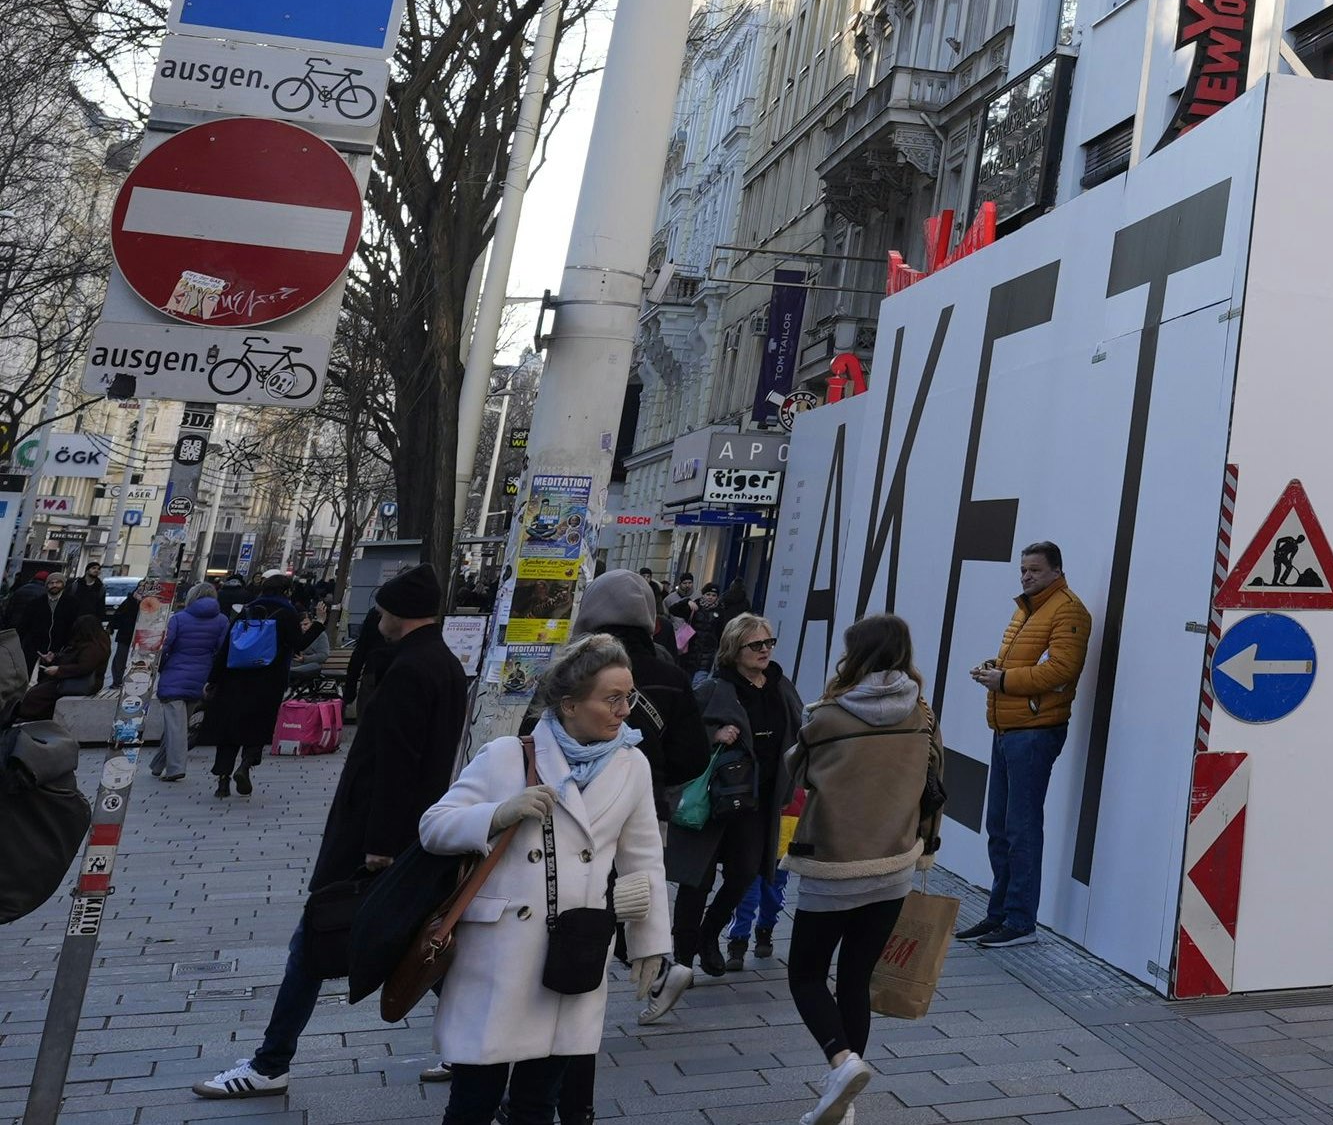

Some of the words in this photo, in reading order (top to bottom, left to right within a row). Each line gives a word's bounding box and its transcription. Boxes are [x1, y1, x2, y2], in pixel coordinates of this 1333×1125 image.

[161, 59, 270, 90] ausgen.
[780, 312, 792, 351] TAILOR
[91, 347, 205, 376] ausgen.
[55, 446, 101, 465] ÖGK
[533, 476, 590, 488] MEDITATION
[710, 492, 772, 502] copenhagen
[616, 515, 651, 525] BOSCH
[508, 645, 553, 653] MEDITATION
[80, 897, 103, 935] KAITO
